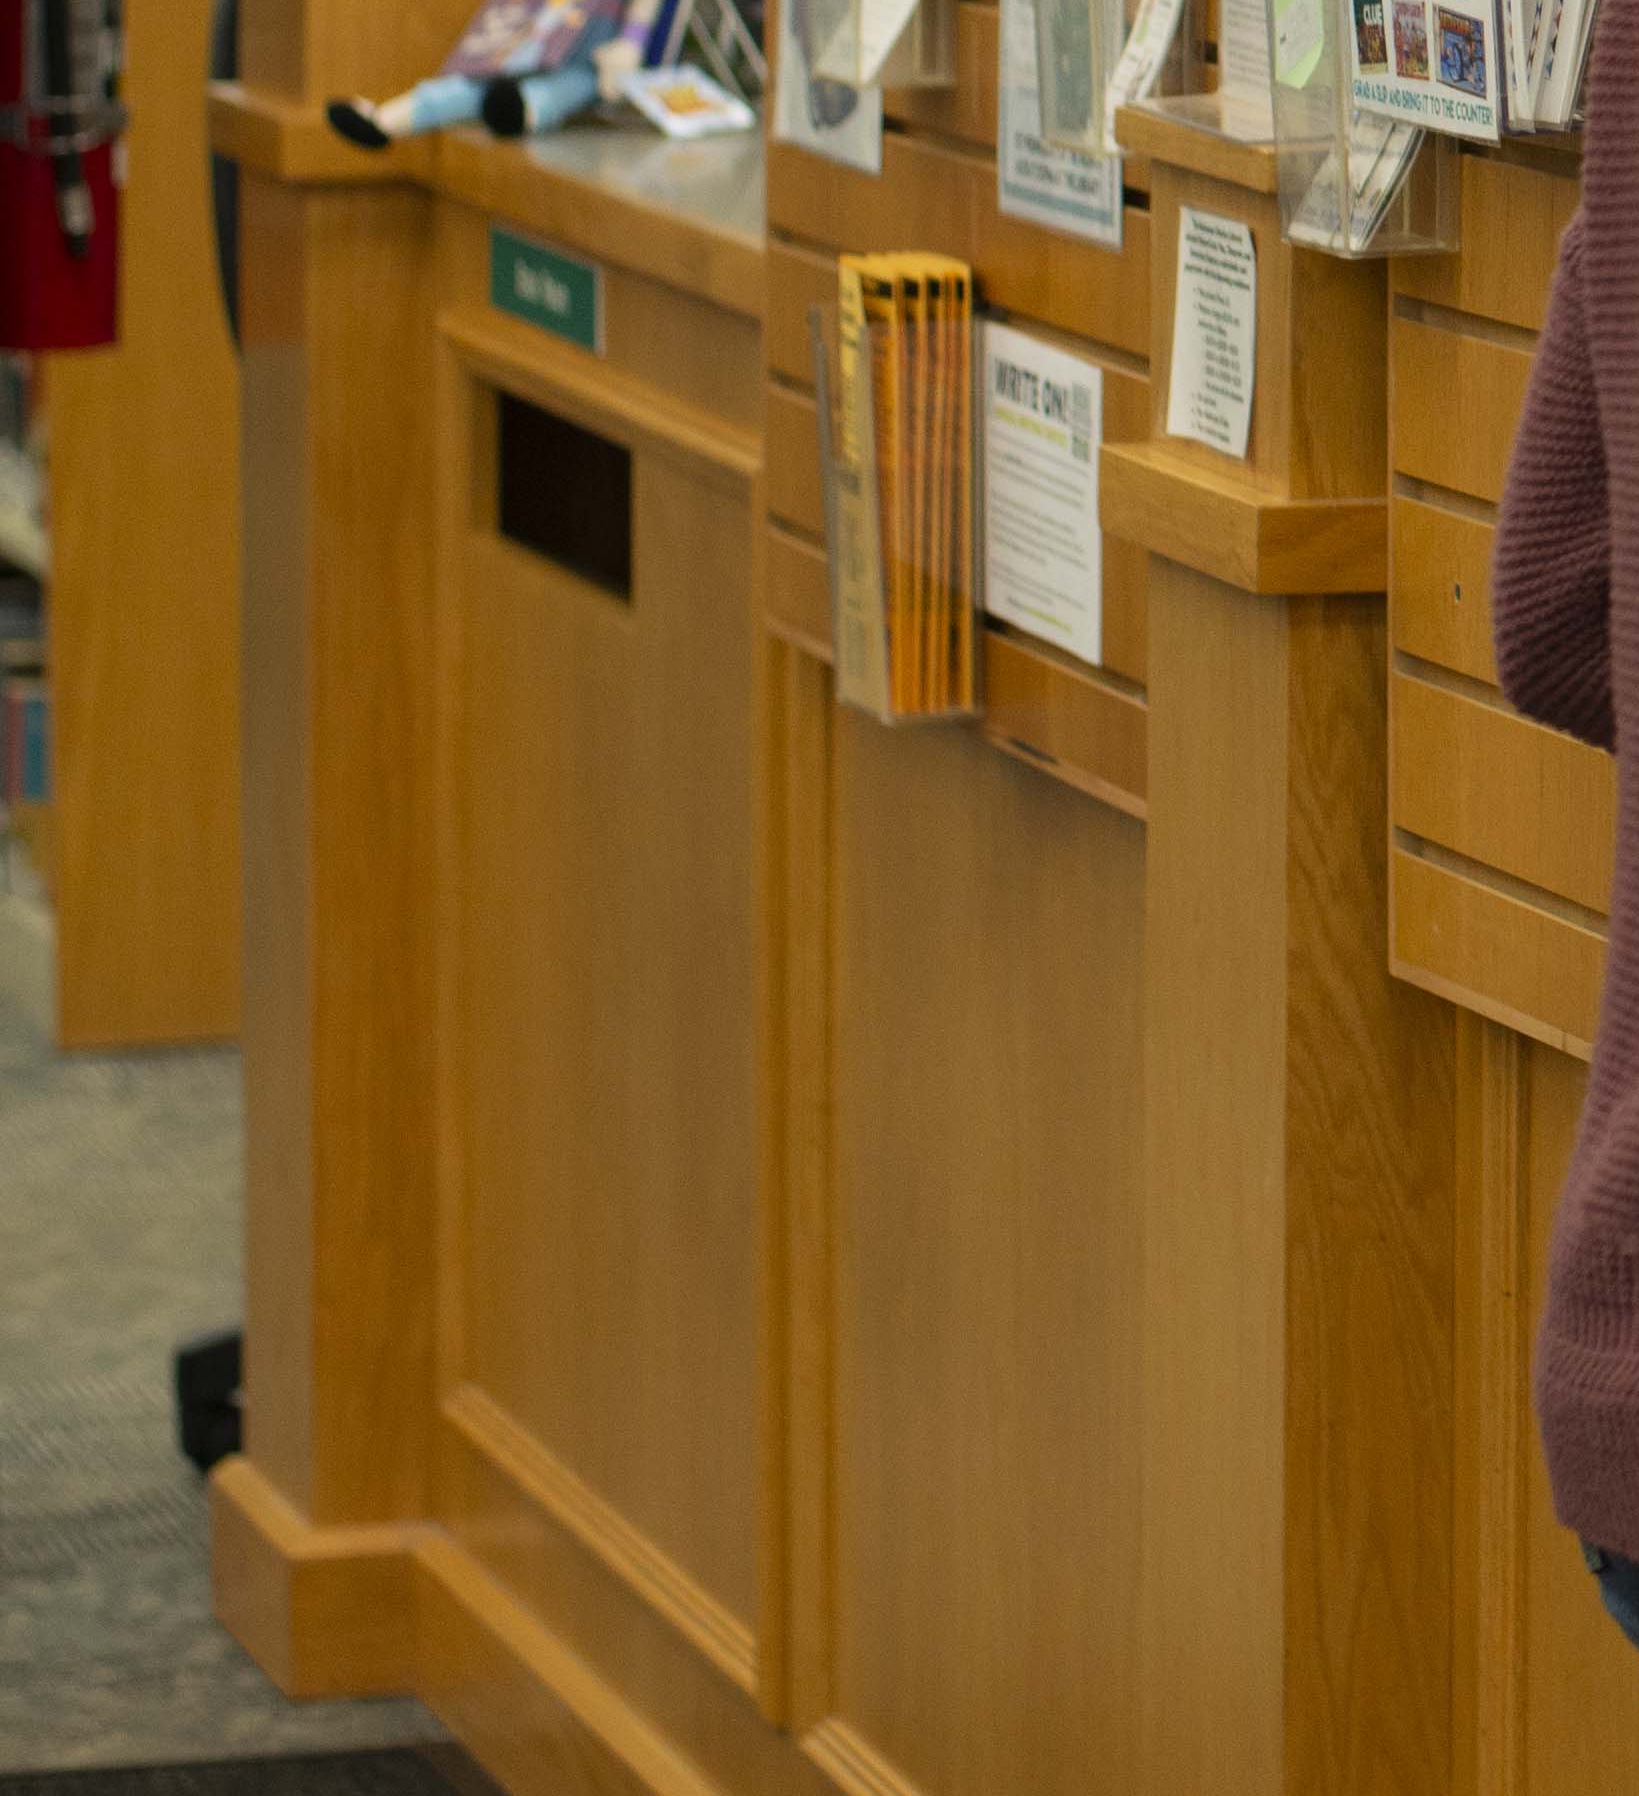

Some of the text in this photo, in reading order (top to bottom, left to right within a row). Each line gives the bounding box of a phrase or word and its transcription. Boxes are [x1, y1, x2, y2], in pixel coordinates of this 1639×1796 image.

[1354, 78, 1370, 100] GRAB
[1401, 90, 1421, 111] BRING
[1429, 95, 1440, 116] TO
[1443, 99, 1455, 120] THE
[994, 356, 1040, 412] WRITE
